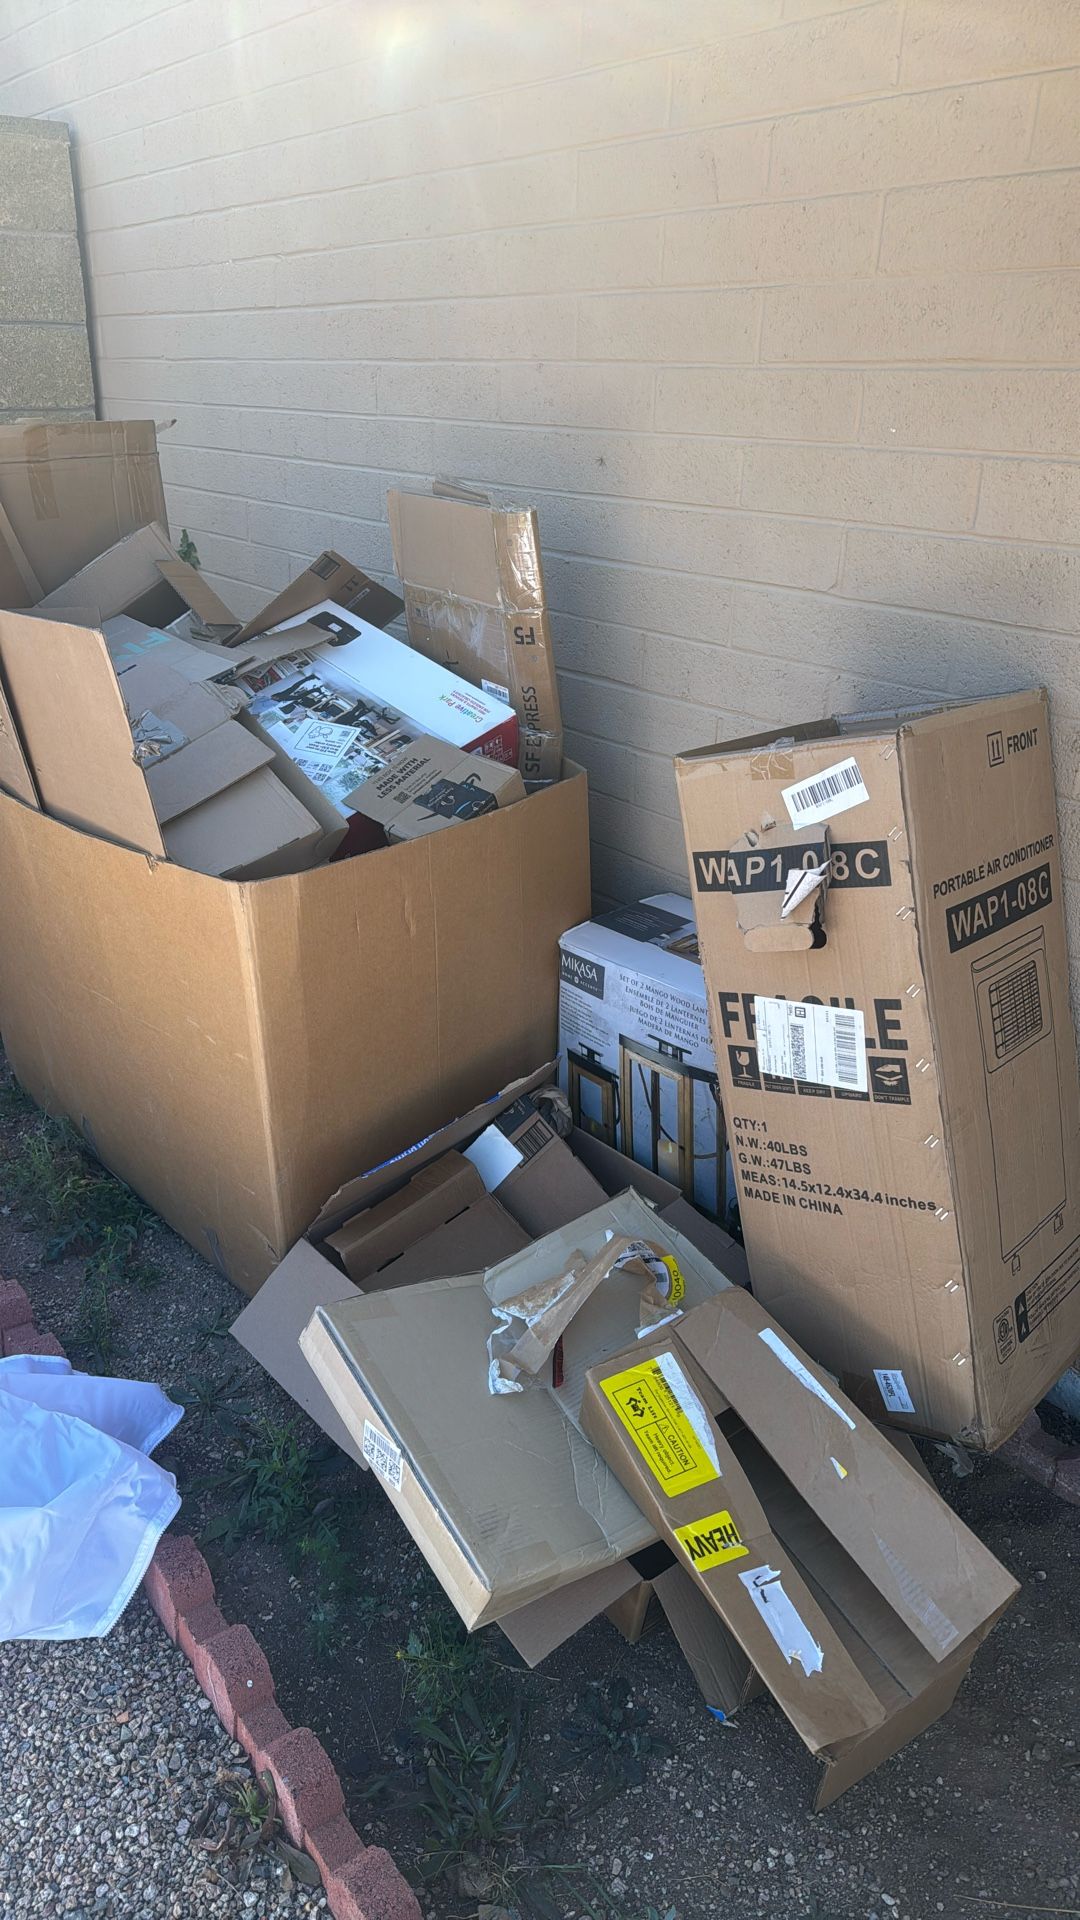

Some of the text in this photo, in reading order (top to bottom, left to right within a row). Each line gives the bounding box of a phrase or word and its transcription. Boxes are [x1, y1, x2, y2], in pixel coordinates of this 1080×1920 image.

[513, 626, 536, 646] F5
[439, 693, 457, 707] Park
[455, 704, 484, 723] Creative
[1007, 728, 1038, 755] FRONT
[376, 773, 398, 791] MADE
[396, 757, 418, 774] WITH
[525, 752, 541, 774] SF
[377, 784, 397, 799] LESS
[394, 757, 431, 786] MATERIAL
[698, 848, 881, 887] WAP108C
[933, 834, 1055, 900] PORTABLE AIR CONDITIONER
[951, 870, 1051, 942] WAP1-08C
[561, 954, 598, 982] MIKASA
[619, 974, 629, 984] SET
[630, 978, 639, 987] OF
[646, 984, 669, 1000] MANGO
[670, 993, 691, 1009] WOOD
[692, 1002, 709, 1016] LANT
[625, 986, 706, 1025] ENSEMBLE DE 2 LANTERNES
[629, 1005, 649, 1019] JUEGO
[650, 1014, 659, 1022] DE
[658, 1017, 663, 1025] 2
[664, 1019, 699, 1041] LINTERNAS
[639, 1000, 700, 1030] BOIS DE MANGUIER
[637, 1017, 700, 1048] MADERA DE MANGO
[733, 1117, 768, 1133] QTY:1
[735, 1134, 808, 1157] N.W.:40LBS
[738, 1152, 811, 1175] G.W.:47LBS
[744, 1186, 843, 1215] MADE IN CHINA
[636, 1387, 648, 1404] Team
[644, 1430, 654, 1444] Team
[653, 1433, 665, 1449] Heavy
[667, 1434, 690, 1466] CAUTION
[683, 1523, 740, 1561] HEAVY
